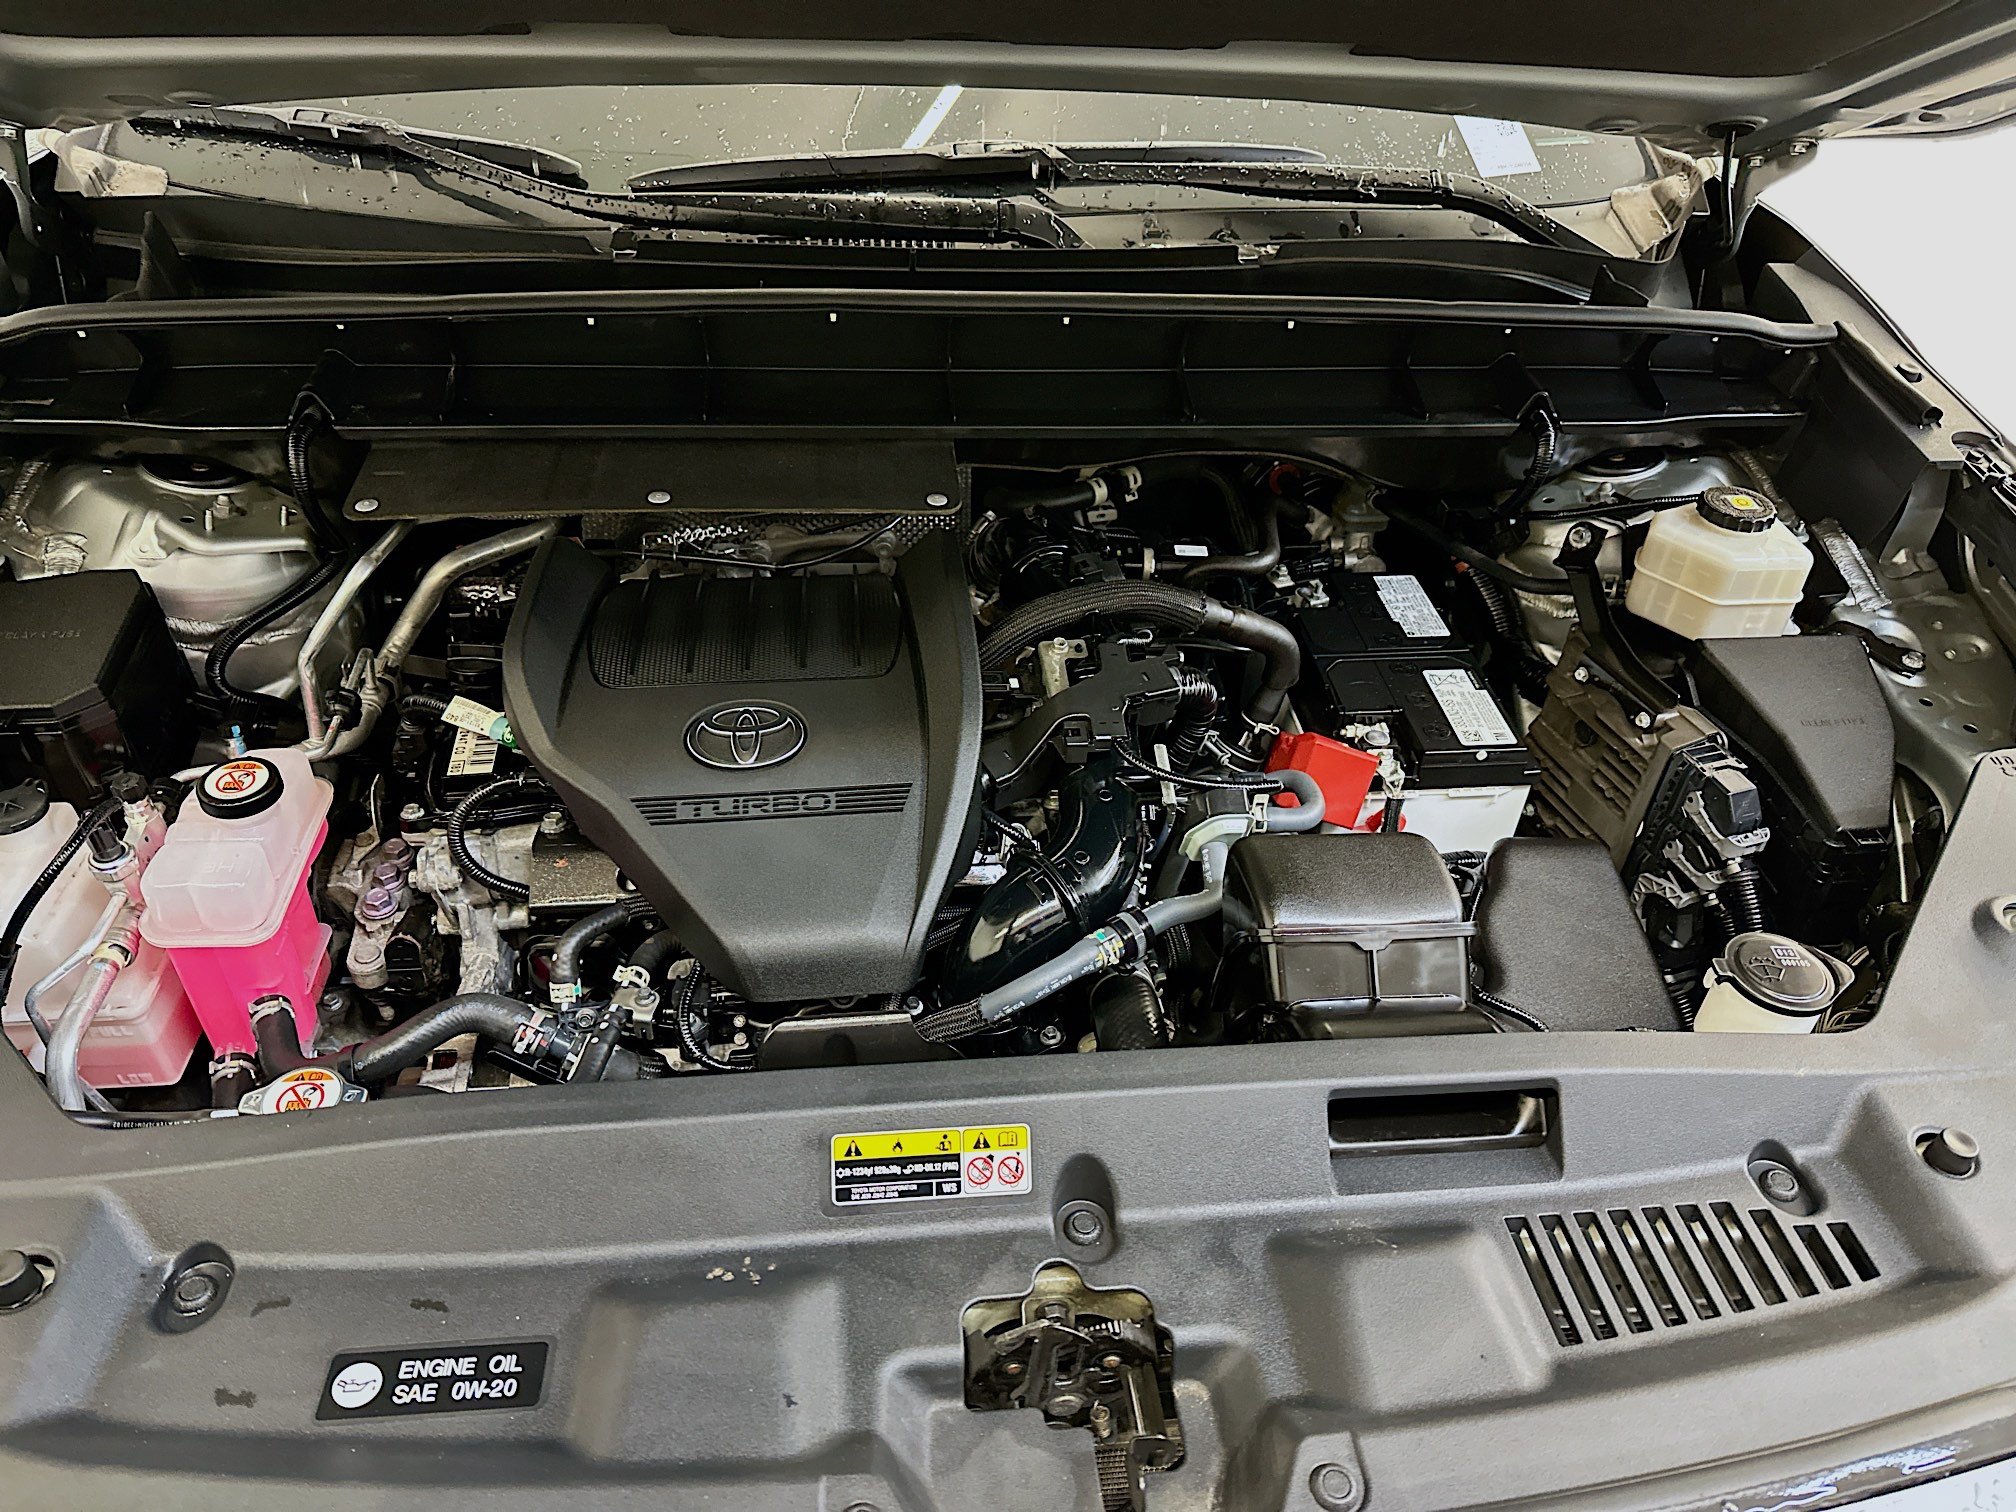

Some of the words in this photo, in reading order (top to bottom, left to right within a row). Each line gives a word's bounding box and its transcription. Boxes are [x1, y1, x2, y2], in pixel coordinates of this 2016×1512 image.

[680, 793, 832, 818] TURBO
[116, 1072, 154, 1085] LOW
[885, 1183, 917, 1192] CORPORATION
[942, 1182, 957, 1193] WS
[398, 1357, 477, 1379] ENGINE
[488, 1354, 523, 1374] OIL
[392, 1382, 439, 1405] SAE
[451, 1378, 518, 1401] 0W-20
